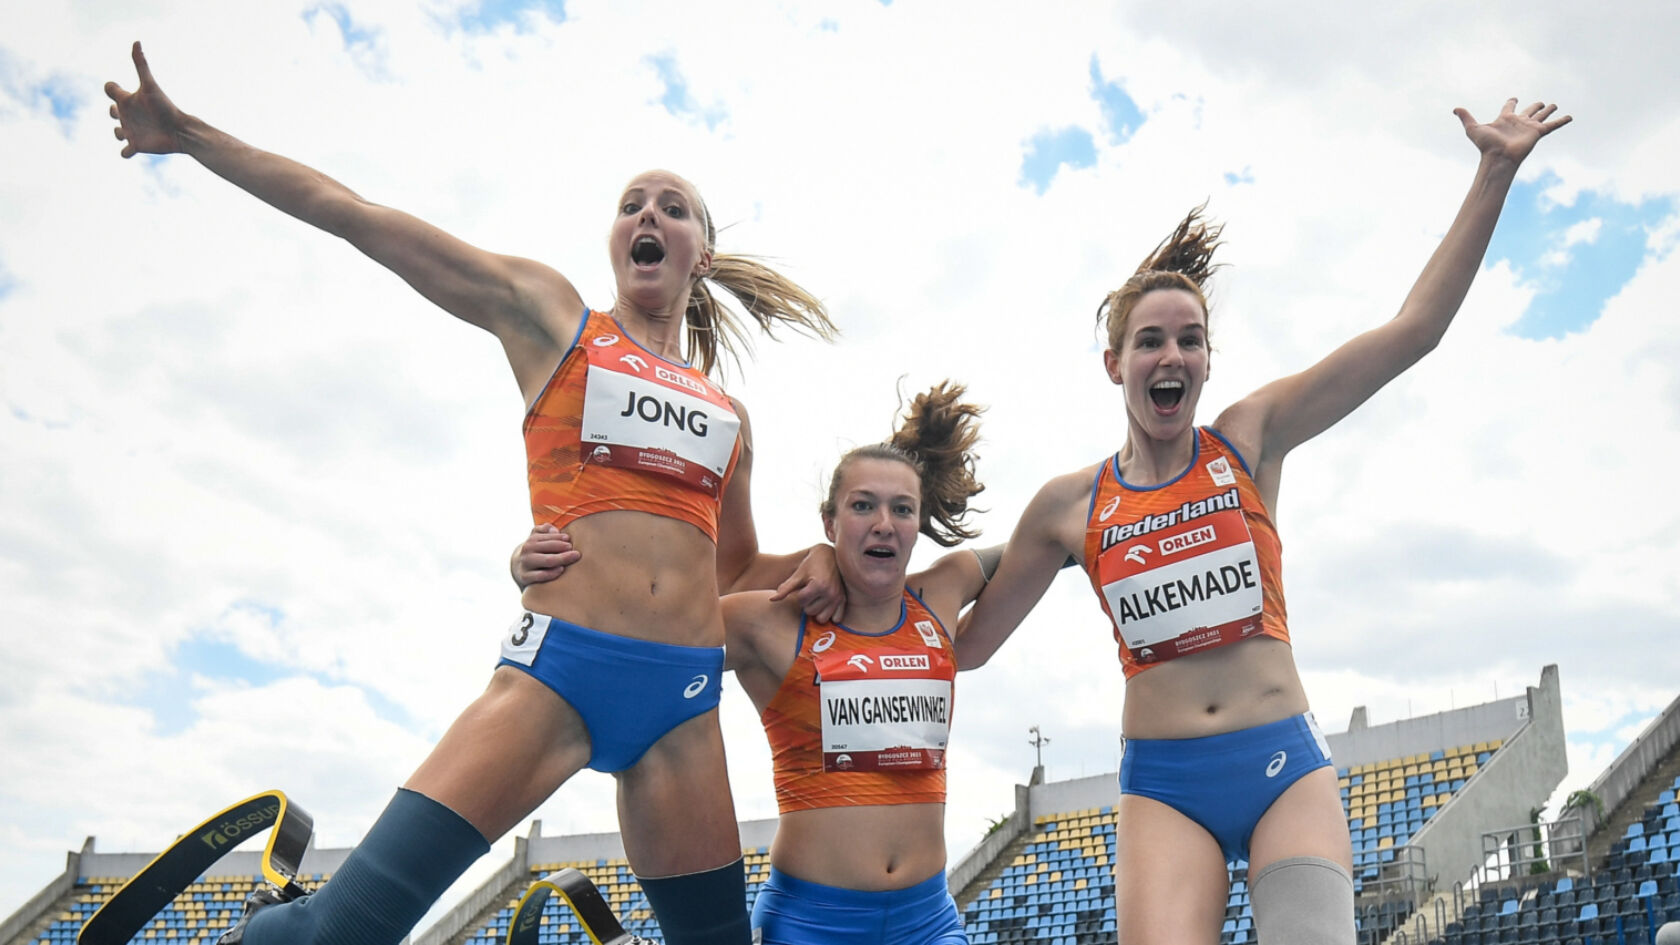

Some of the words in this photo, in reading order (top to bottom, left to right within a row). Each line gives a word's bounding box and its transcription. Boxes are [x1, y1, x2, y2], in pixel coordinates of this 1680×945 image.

[658, 370, 704, 393] ORLEN
[621, 391, 708, 438] JONG
[1163, 528, 1211, 552] ORLEN
[1119, 560, 1256, 625] ALKEMADE
[511, 612, 534, 647] 3
[883, 657, 927, 668] ORLEN
[828, 697, 859, 726] VAN
[862, 696, 946, 724] GANSEWINKEL
